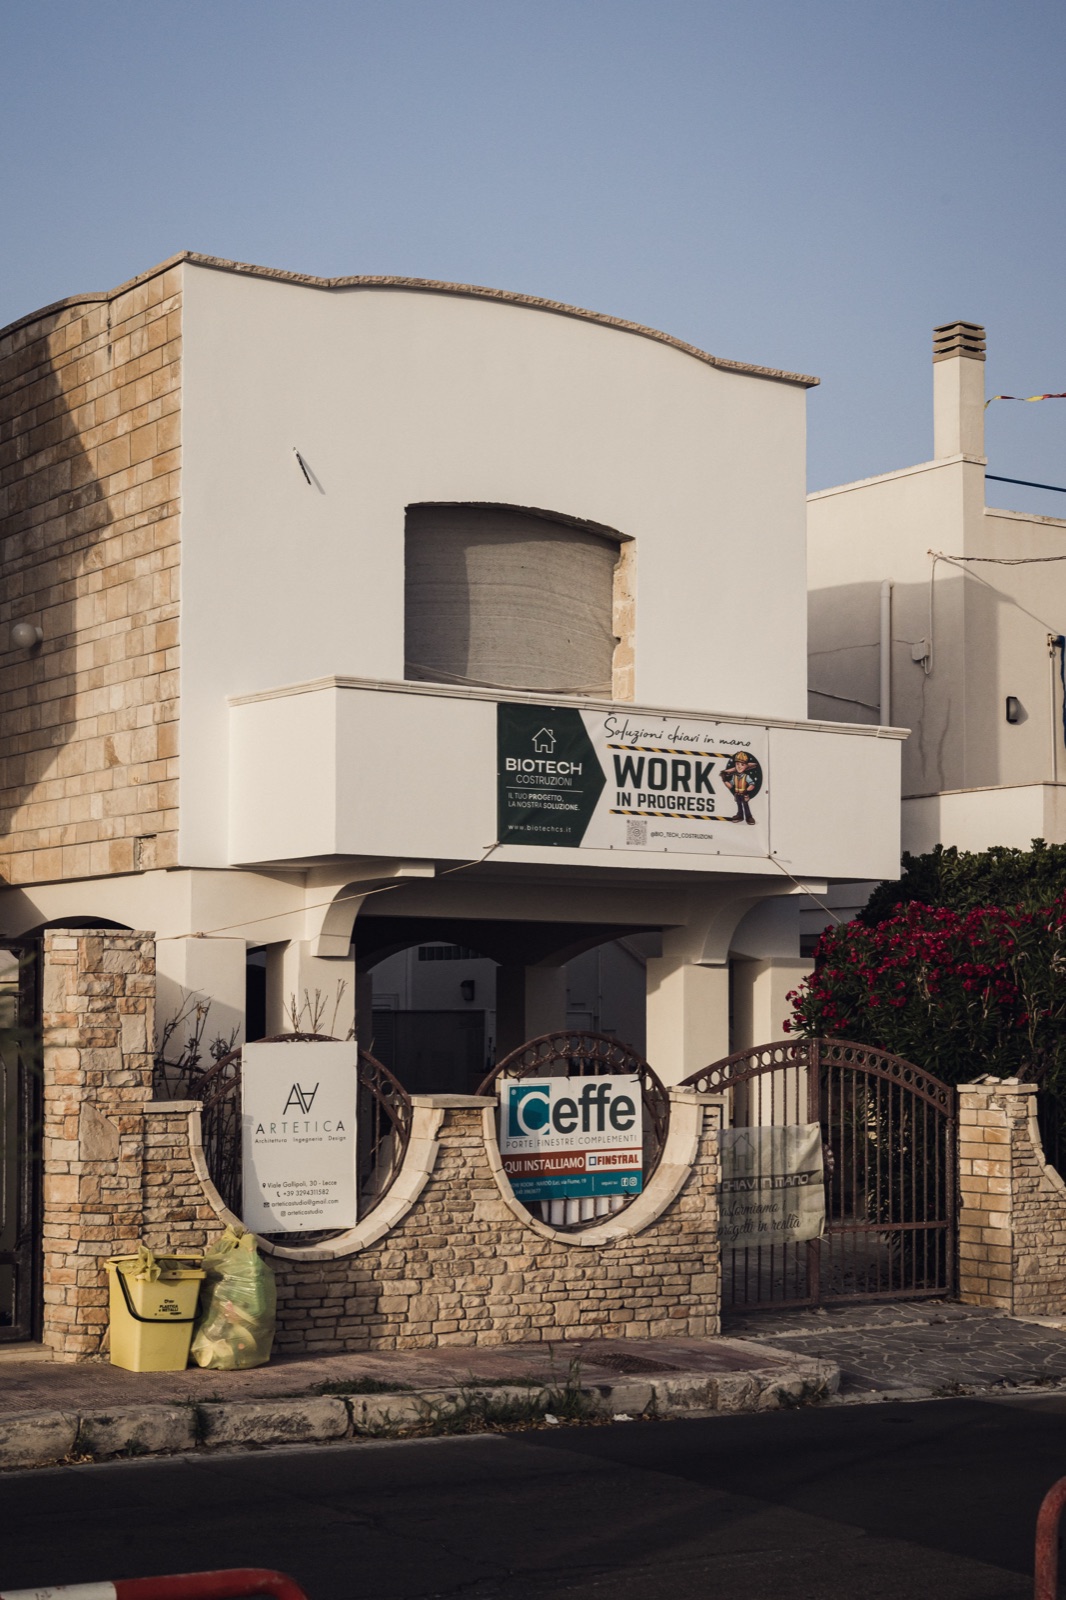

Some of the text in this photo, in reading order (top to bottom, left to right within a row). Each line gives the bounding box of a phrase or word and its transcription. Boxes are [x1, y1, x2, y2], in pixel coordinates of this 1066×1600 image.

[603, 716, 752, 747] Soluzioni chiavi in mano
[505, 757, 583, 776] BIOTECH
[516, 774, 573, 787] COSTRUZIONI
[613, 754, 716, 795] WORK
[515, 792, 528, 800] TUO
[528, 793, 565, 803] PROGETTO,
[517, 801, 542, 809] NOSTRA
[616, 791, 716, 813] IN PROGRESS
[516, 1082, 637, 1137] Ceffe
[255, 1120, 346, 1135] ARTETICA
[293, 1136, 323, 1144] Ingegneria
[506, 1134, 638, 1149] PORTE FINESTRE COMPLEMENTI
[504, 1154, 640, 1173] QUI INSTALLIAMO FINSTRAL
[267, 1181, 282, 1189] Viale
[282, 1180, 308, 1188] Gallipoli,
[271, 1198, 339, 1207] arteticastudio@gmail.com
[287, 1208, 324, 1216] arteticastudio
